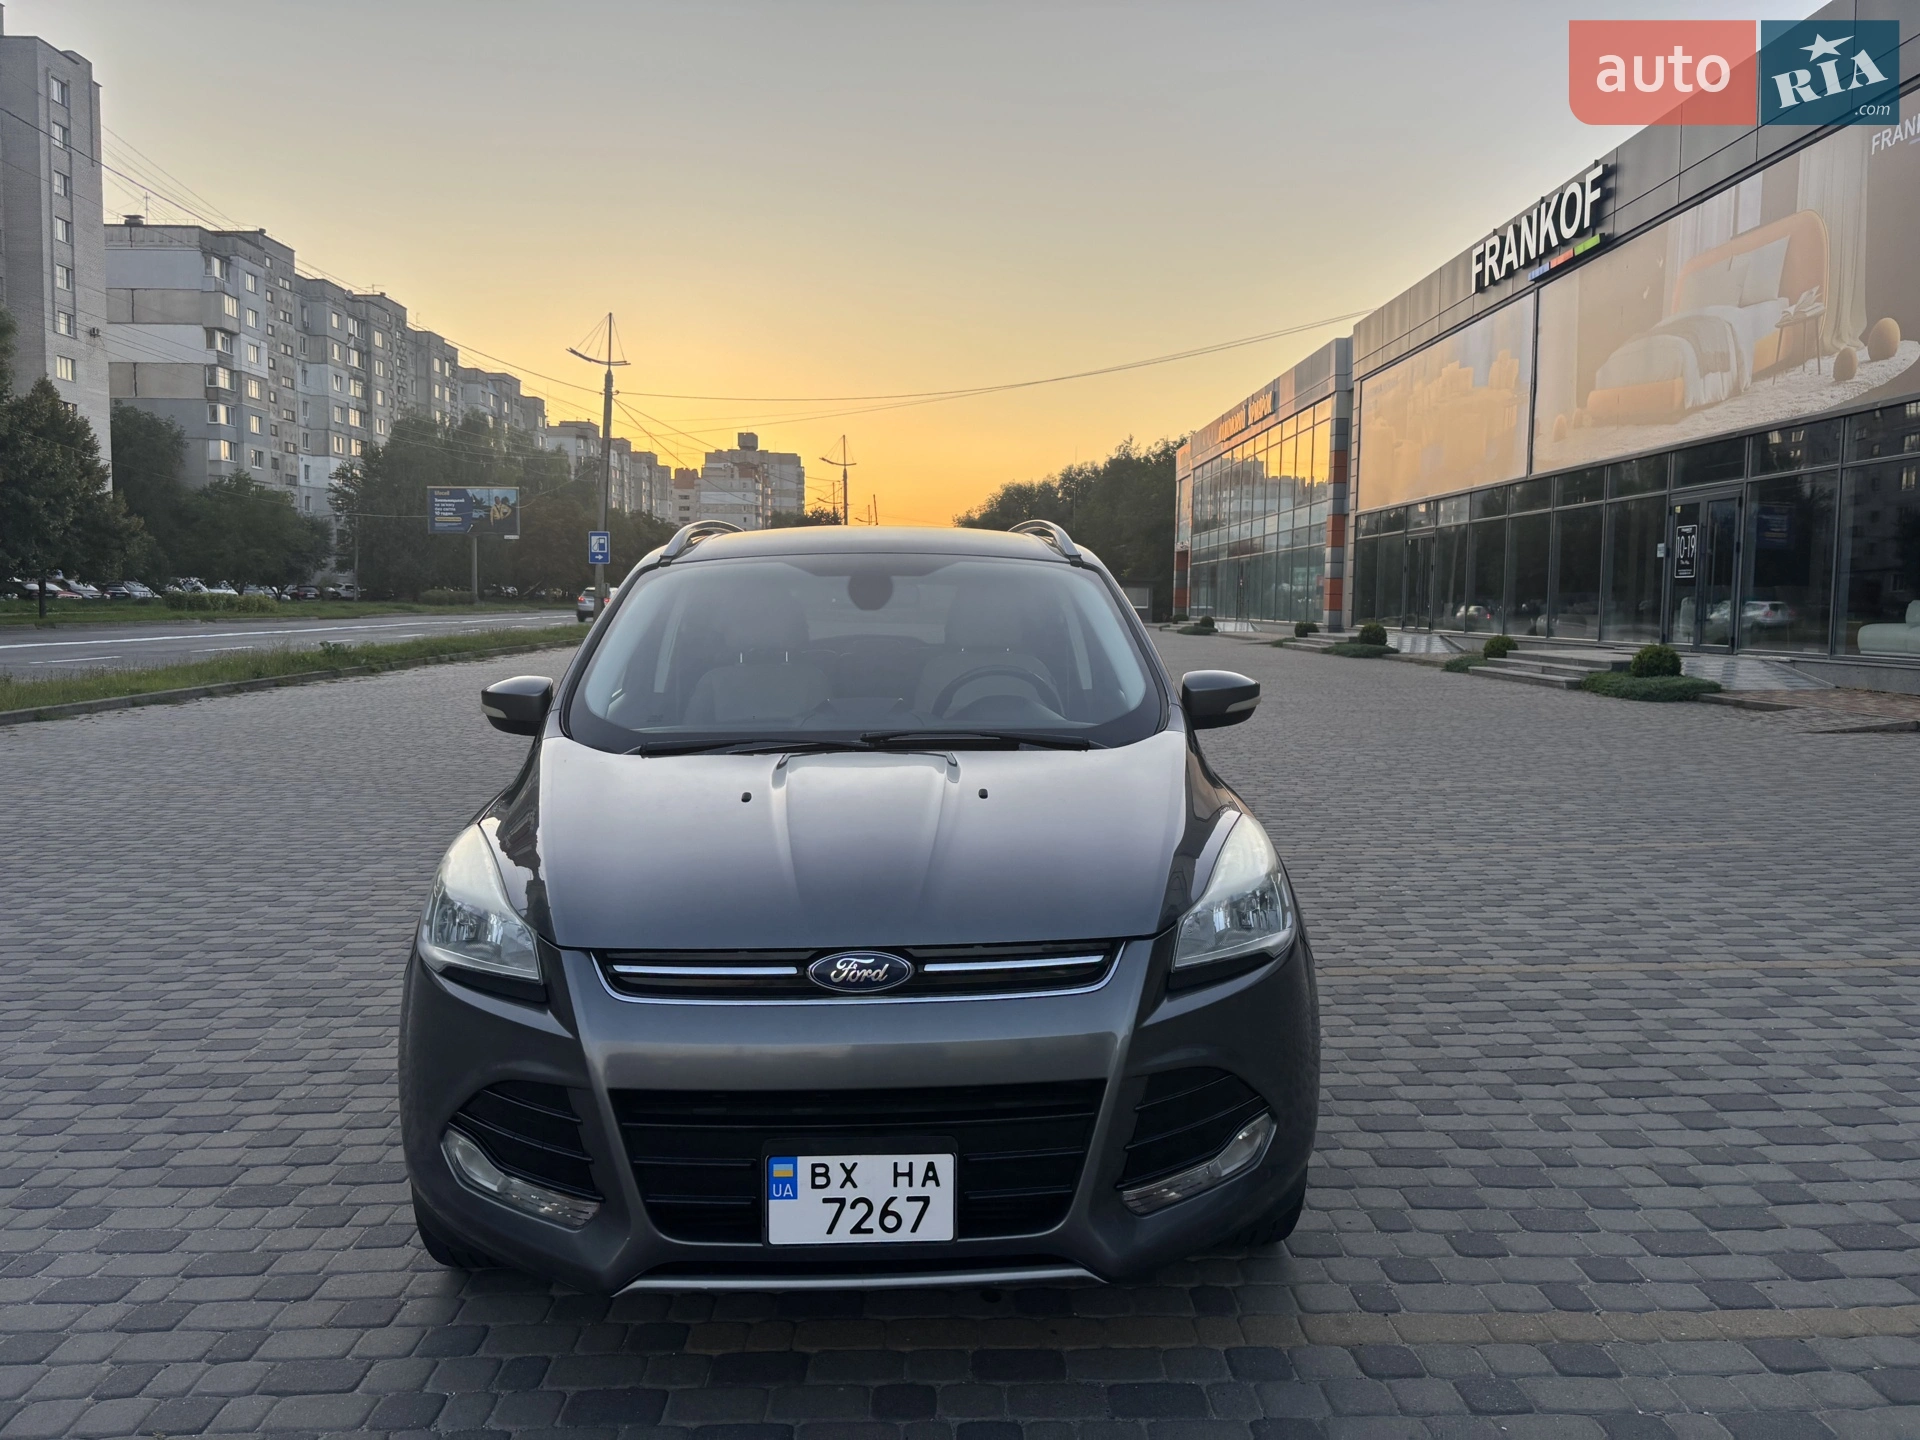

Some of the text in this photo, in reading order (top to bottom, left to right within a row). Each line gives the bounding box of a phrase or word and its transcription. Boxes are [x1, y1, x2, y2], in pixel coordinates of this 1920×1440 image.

[1871, 112, 1920, 156] FRAN
[1471, 164, 1605, 295] FRANKOF
[1677, 535, 1696, 558] 10-19
[830, 957, 889, 983] Ford
[810, 1161, 941, 1189] BX HA
[772, 1183, 794, 1197] UA
[822, 1195, 931, 1235] 7267
